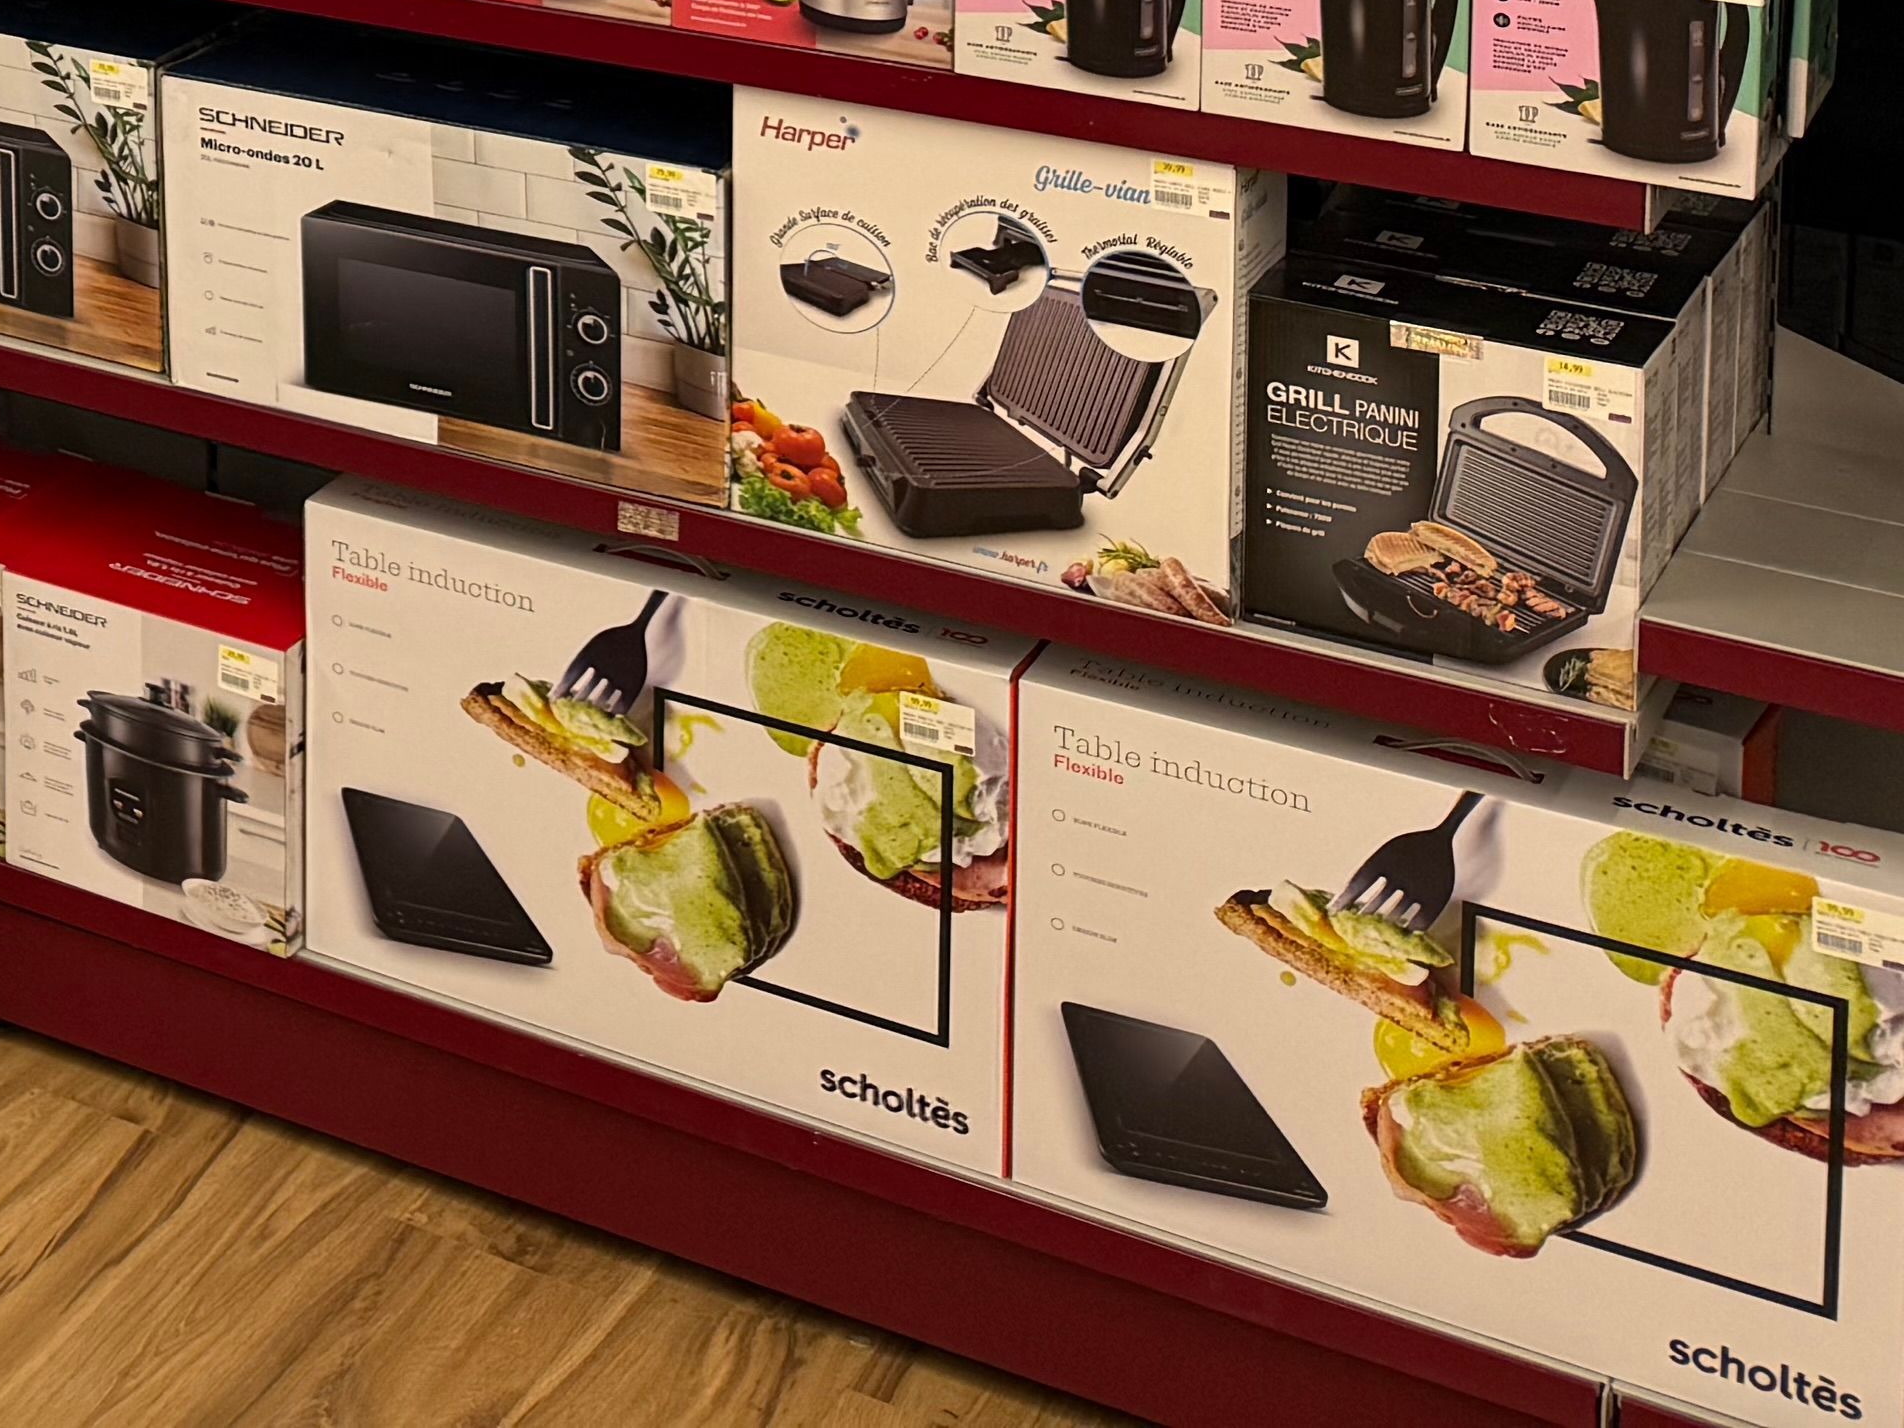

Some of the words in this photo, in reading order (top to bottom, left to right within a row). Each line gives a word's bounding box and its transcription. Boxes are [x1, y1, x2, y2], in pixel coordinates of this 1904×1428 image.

[199, 107, 344, 146] SCHNEIDER
[760, 116, 857, 152] Harper
[200, 137, 290, 165] Micro-ondes
[292, 153, 312, 168] 20
[316, 158, 324, 170] L
[1266, 381, 1351, 414] GRILL
[1355, 400, 1419, 429] PANINI
[1267, 405, 1418, 452] ELECTRIQUE
[332, 540, 401, 579] Table
[410, 567, 534, 612] induction
[332, 566, 388, 592] Flexible
[1053, 754, 1125, 785] Flexible
[1054, 725, 1141, 770] Table
[1150, 751, 1311, 813] induction
